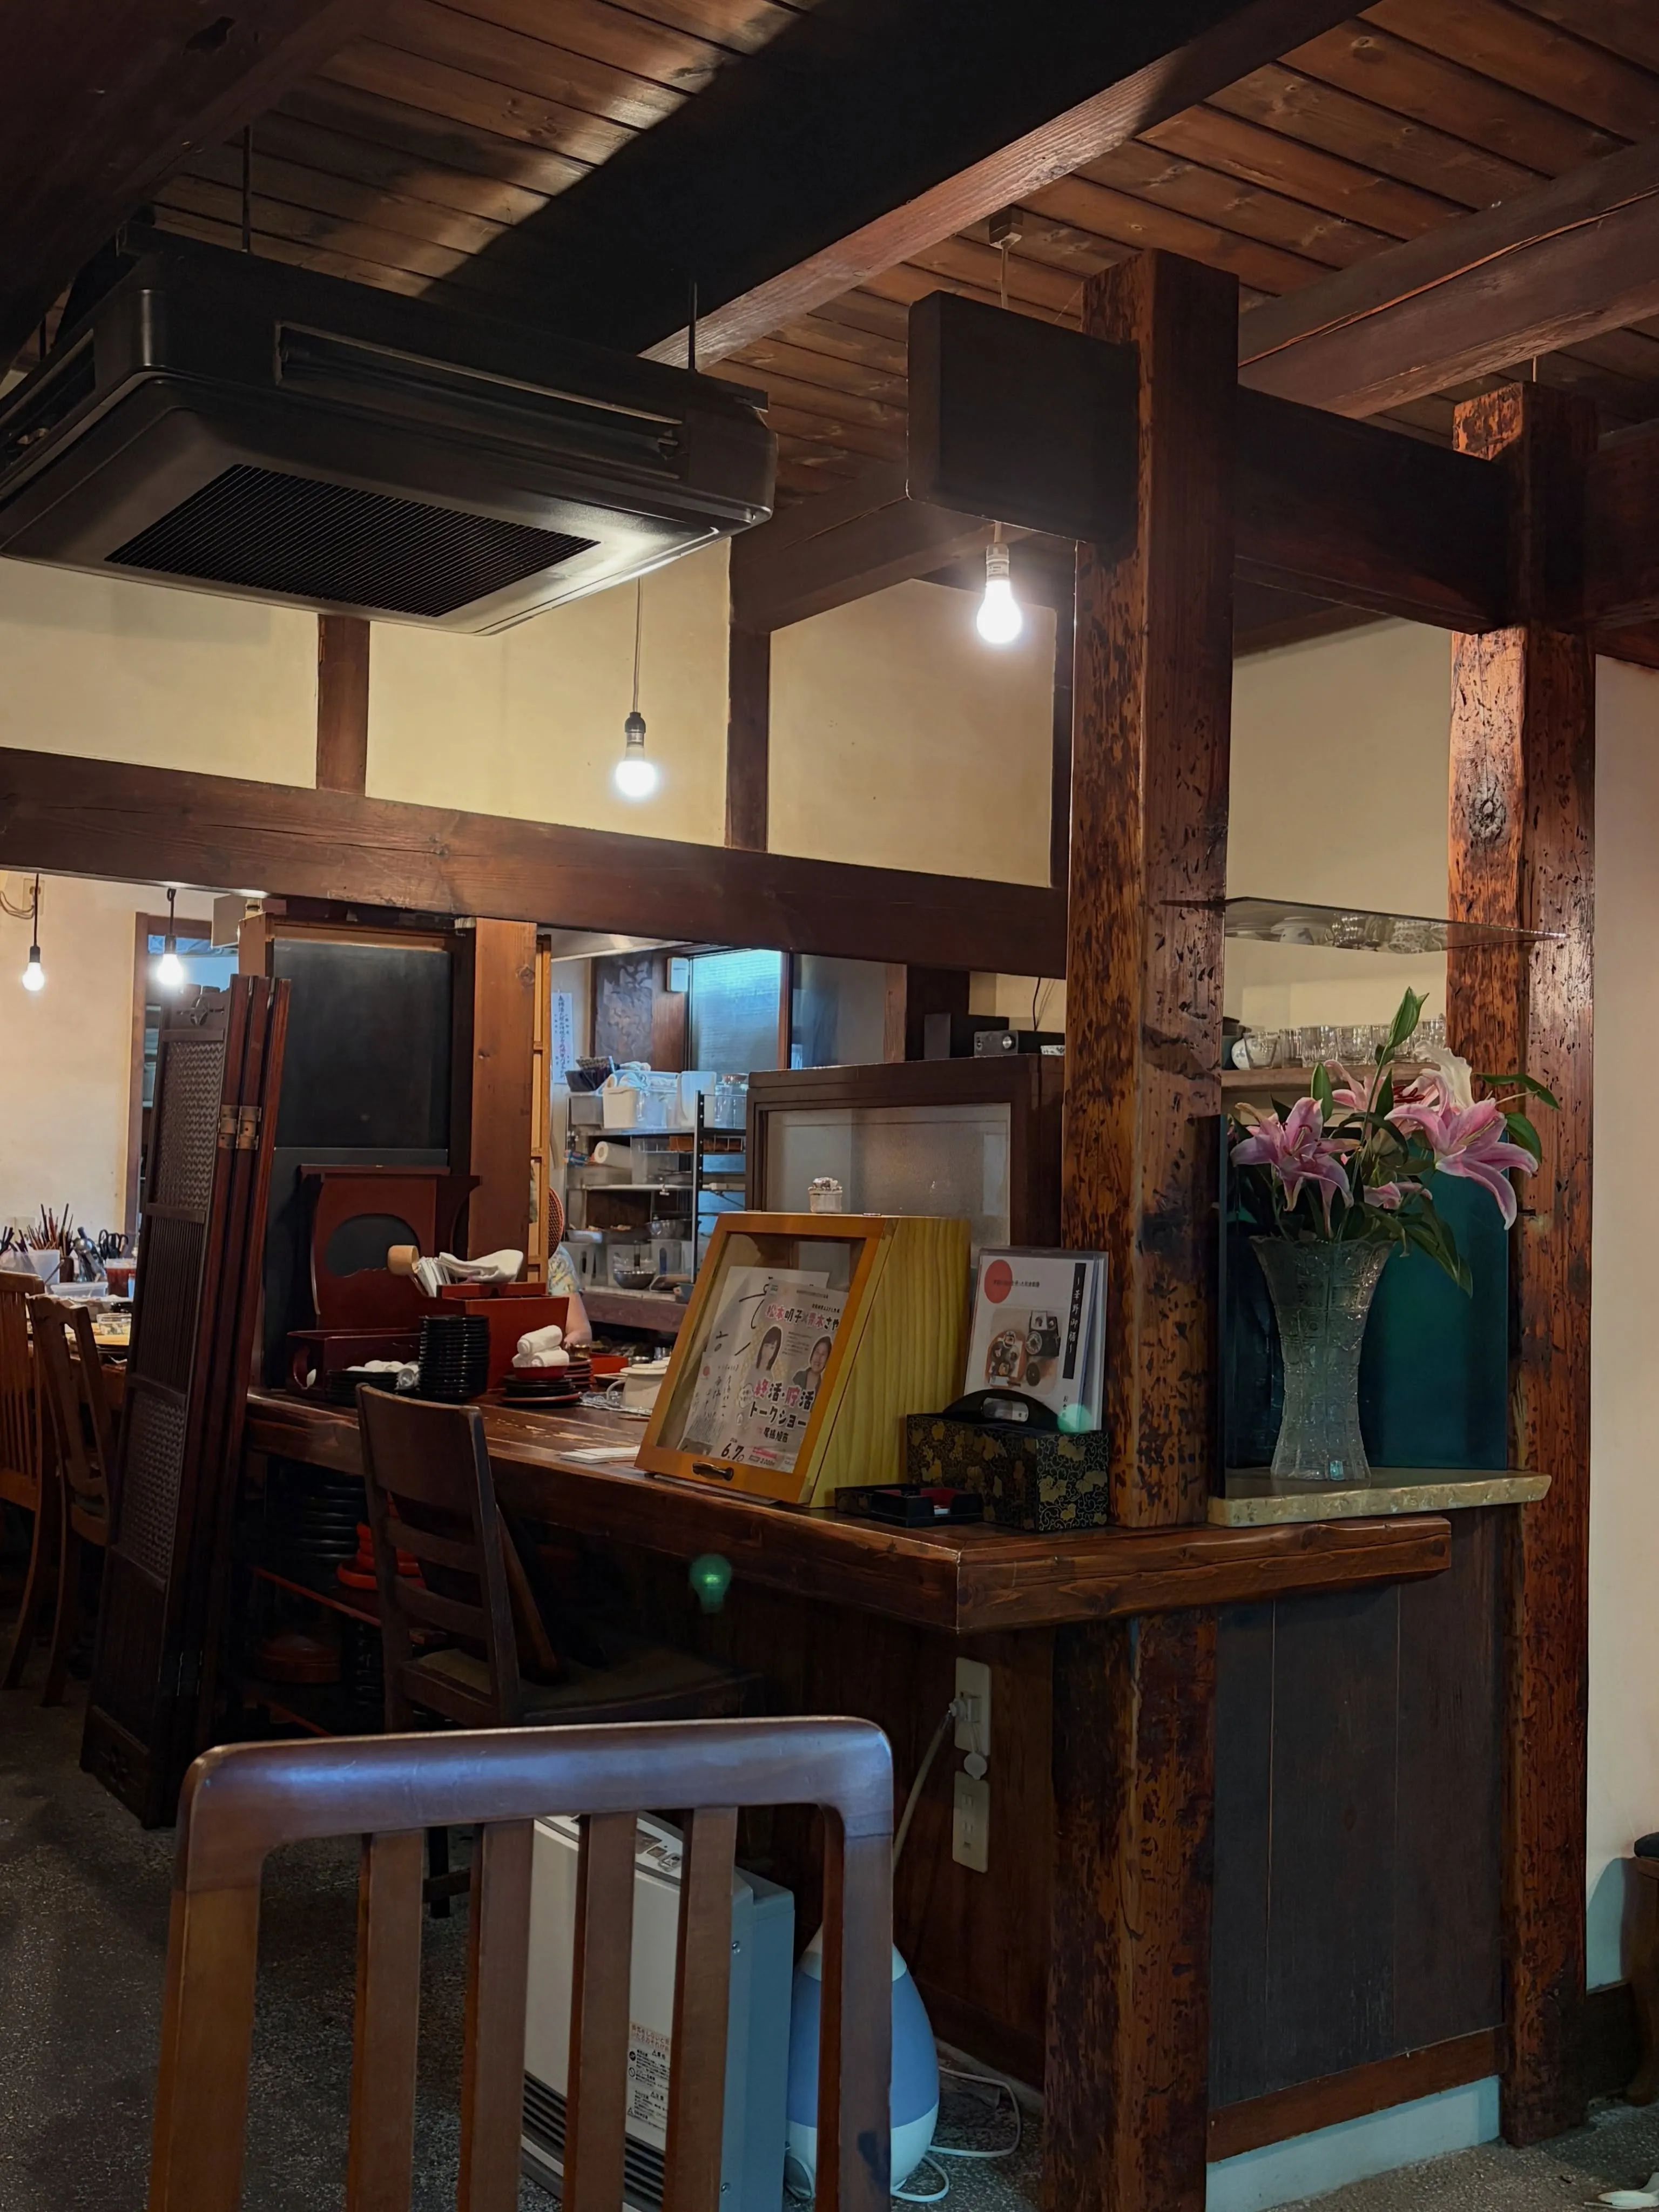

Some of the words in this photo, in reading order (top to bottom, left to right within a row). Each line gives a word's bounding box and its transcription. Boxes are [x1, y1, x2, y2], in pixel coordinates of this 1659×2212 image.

[750, 1400, 807, 1428] トークショー
